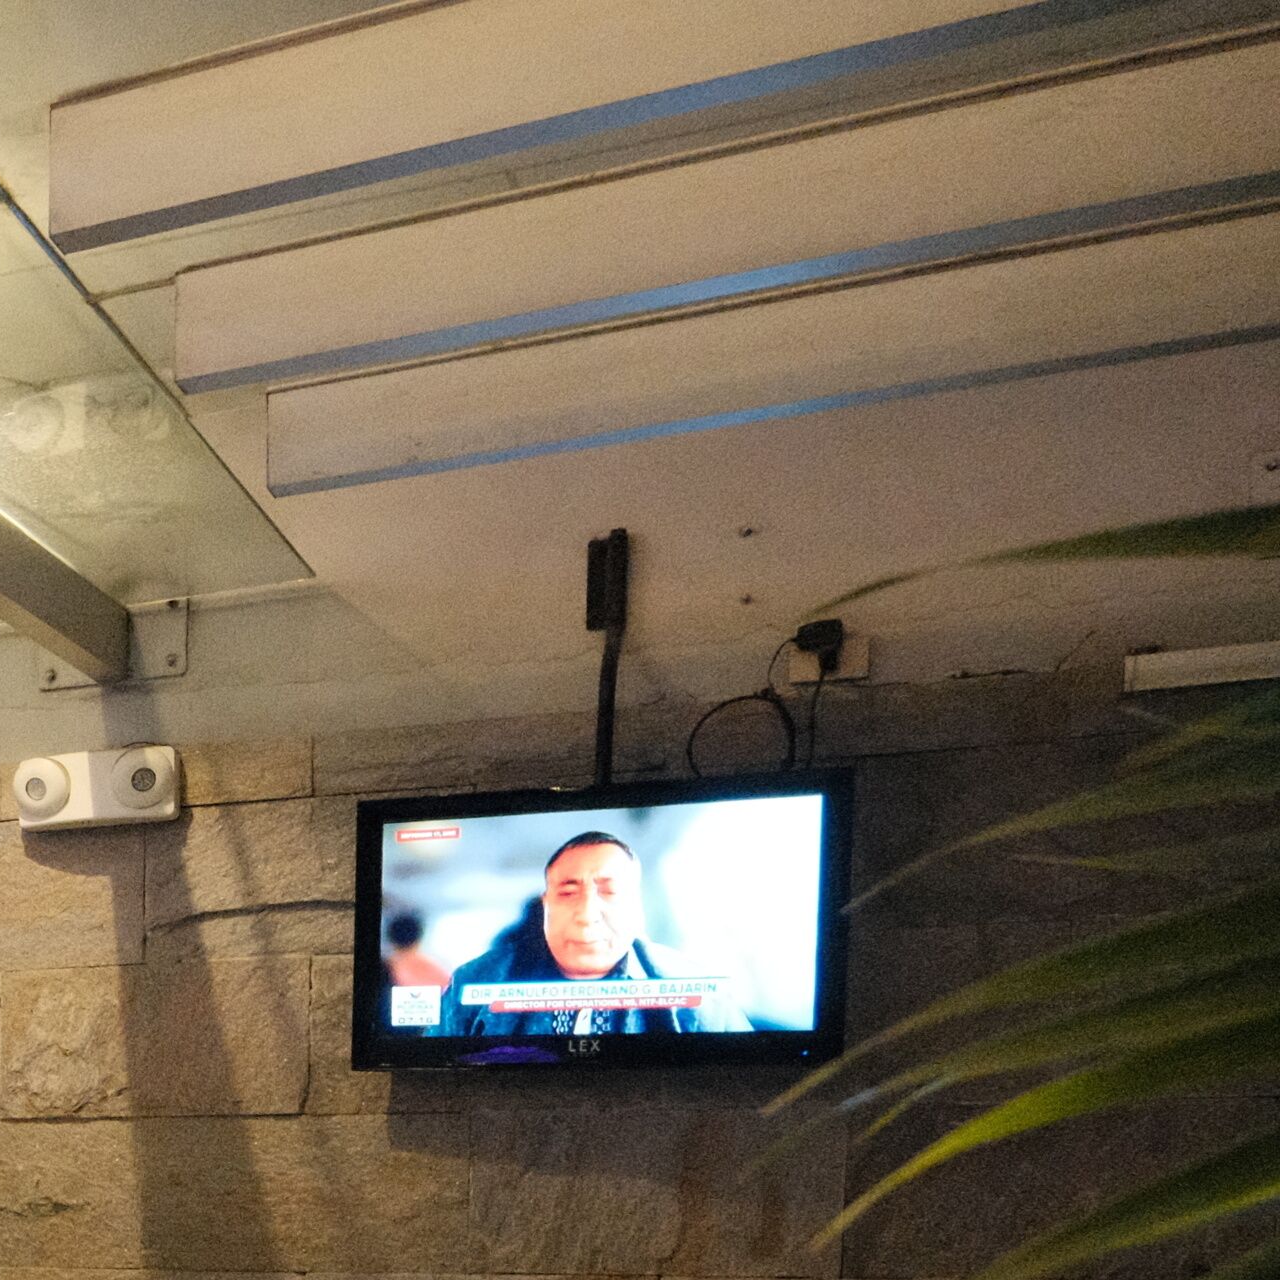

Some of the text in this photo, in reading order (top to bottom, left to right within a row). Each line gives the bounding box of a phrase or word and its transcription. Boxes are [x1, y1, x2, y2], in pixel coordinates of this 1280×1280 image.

[562, 984, 638, 997] FERDINAND
[659, 983, 717, 994] BAJARIN
[503, 1000, 545, 1009] DIRECTOR
[546, 1000, 564, 1008] FOR
[569, 1040, 600, 1052] LEX
